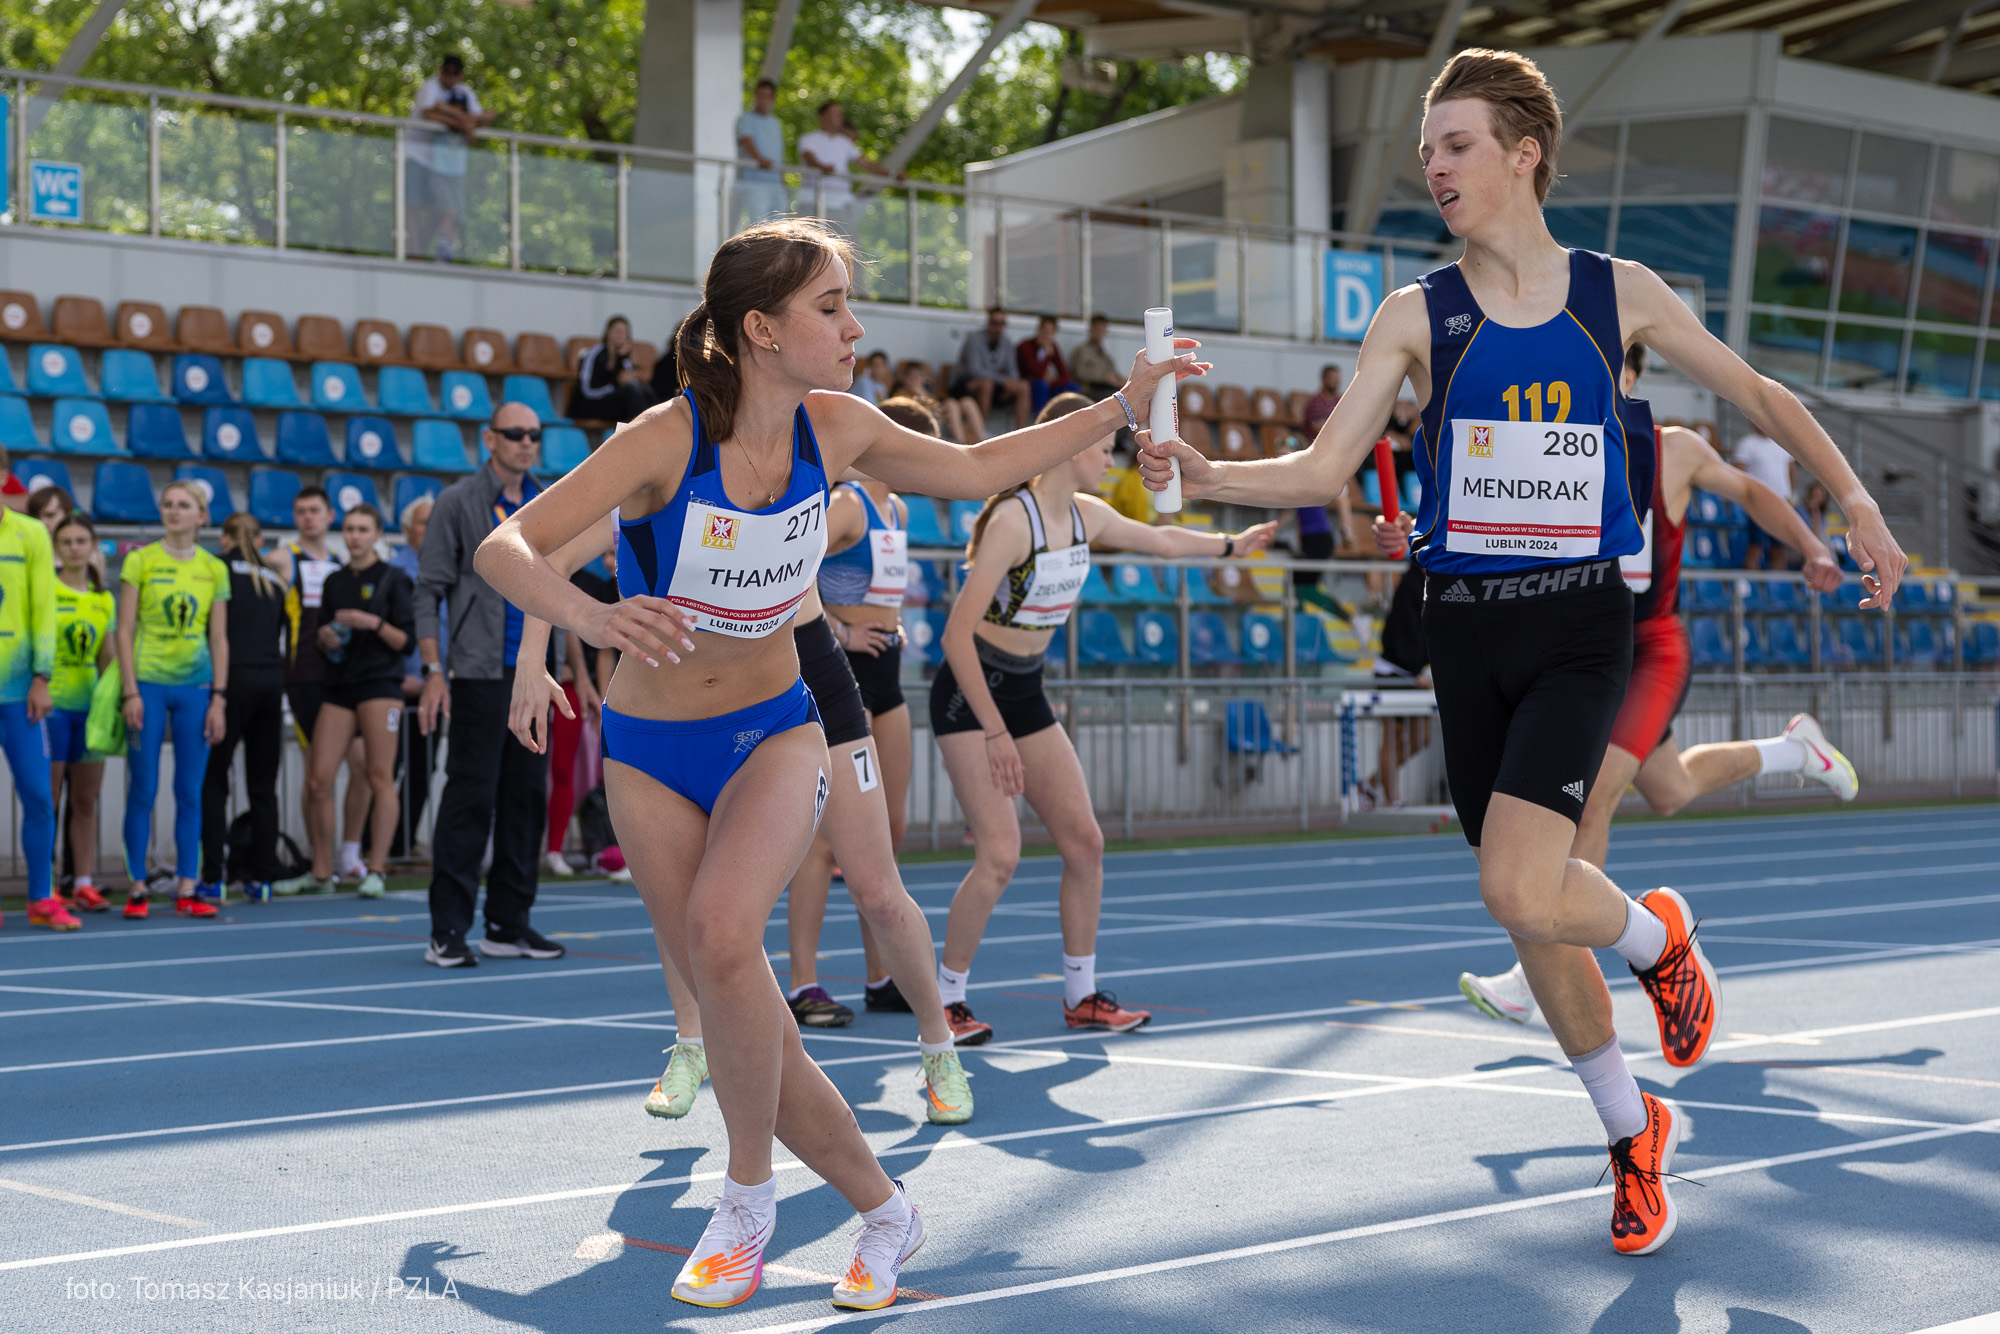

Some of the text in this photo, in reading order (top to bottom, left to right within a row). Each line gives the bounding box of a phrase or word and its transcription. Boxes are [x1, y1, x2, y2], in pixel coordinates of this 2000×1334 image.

[34, 169, 78, 200] WC
[1335, 274, 1374, 333] D
[1502, 380, 1571, 424] 112
[1469, 446, 1492, 457] PZLA
[1543, 430, 1598, 458] 280
[1462, 476, 1590, 501] MENDRAK
[784, 501, 821, 543] 277
[1464, 524, 1500, 532] MISTRZOSTWA
[1528, 527, 1563, 535] SZTAFETACH
[703, 536, 734, 549] PZLA
[1485, 538, 1558, 551] LUBLIN 2024
[708, 558, 804, 588] THAMM
[1481, 561, 1612, 601] TECHFIT
[671, 597, 686, 605] PZLA
[686, 600, 729, 617] MISTRZOSTWA
[1440, 592, 1476, 603] adidas
[709, 617, 780, 633] LUBLIN 2024
[853, 749, 870, 783] 7
[1561, 785, 1584, 804] adidas
[1650, 1097, 1661, 1153] balance
